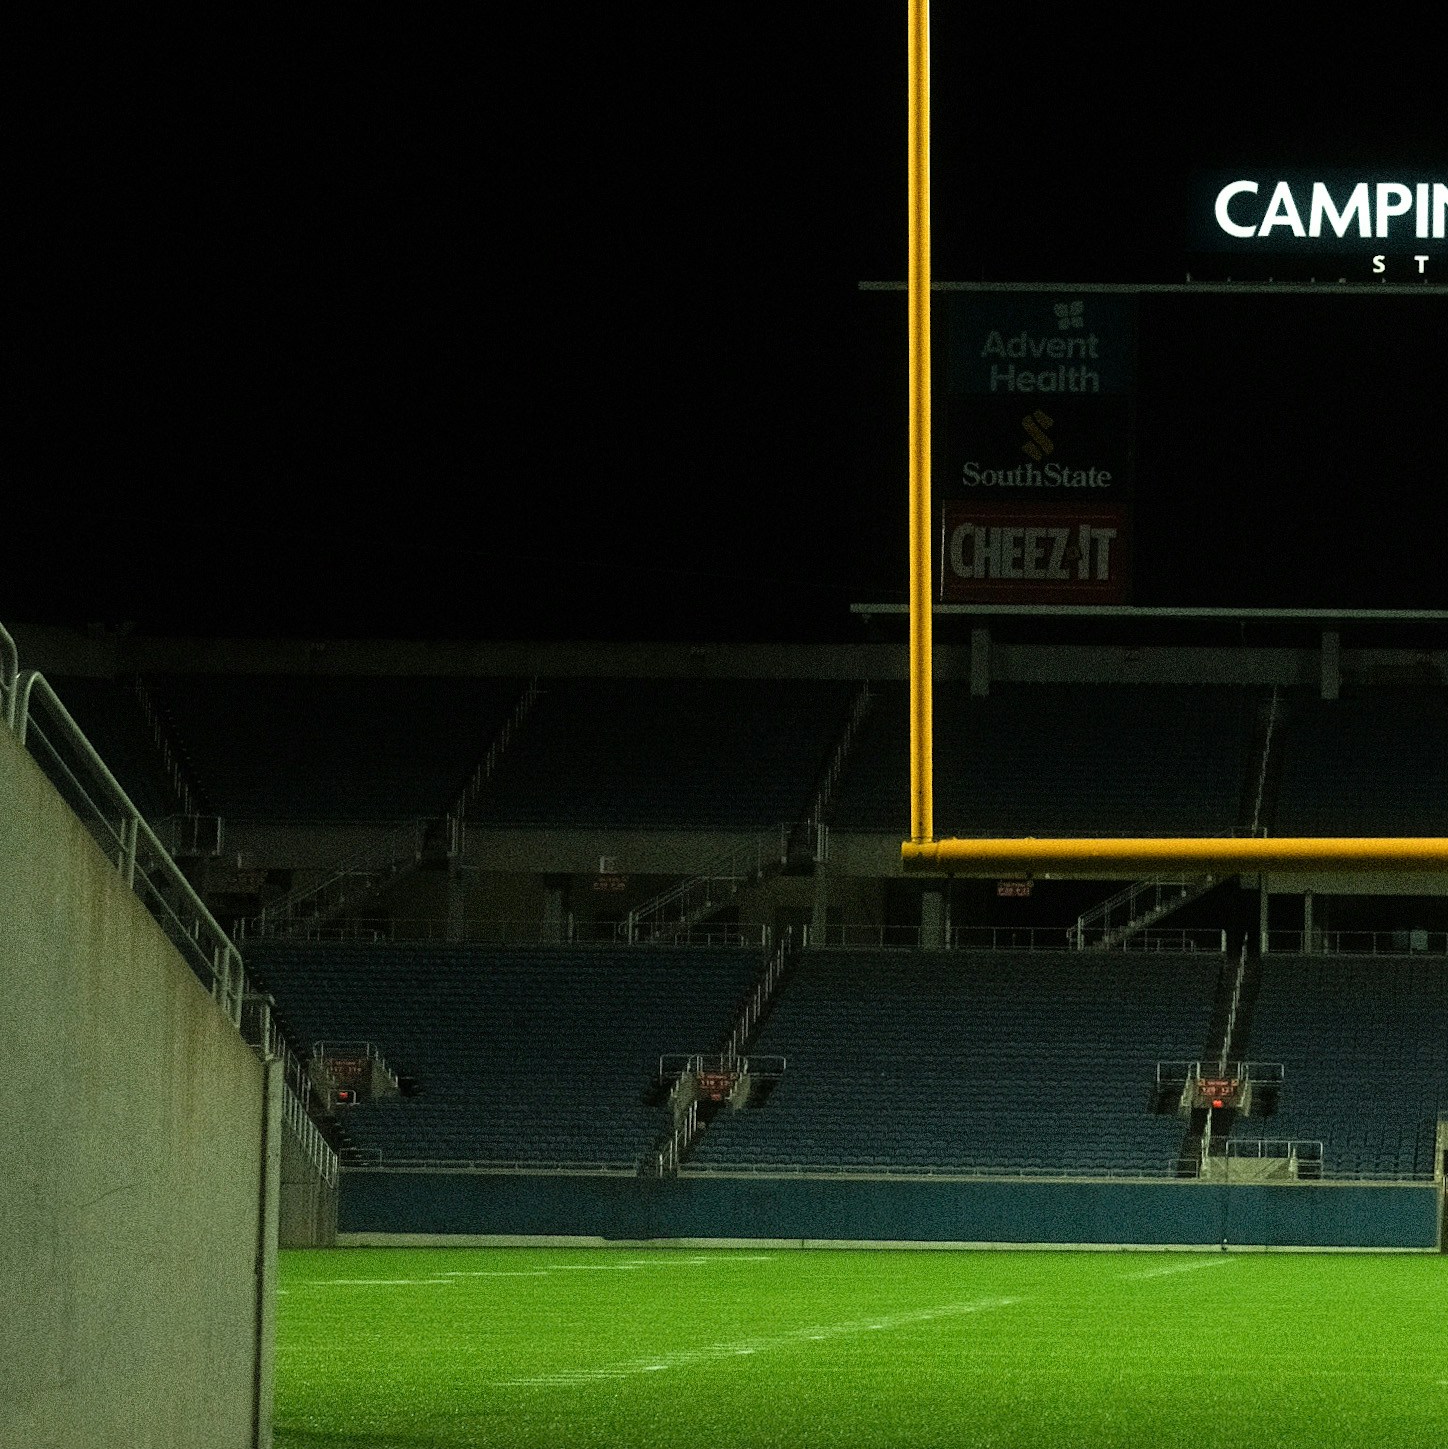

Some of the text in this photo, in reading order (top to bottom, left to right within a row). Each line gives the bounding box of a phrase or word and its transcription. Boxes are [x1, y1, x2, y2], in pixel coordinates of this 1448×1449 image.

[980, 329, 1099, 359] Advent
[990, 363, 1100, 393] Health
[962, 462, 1113, 488] SouthState
